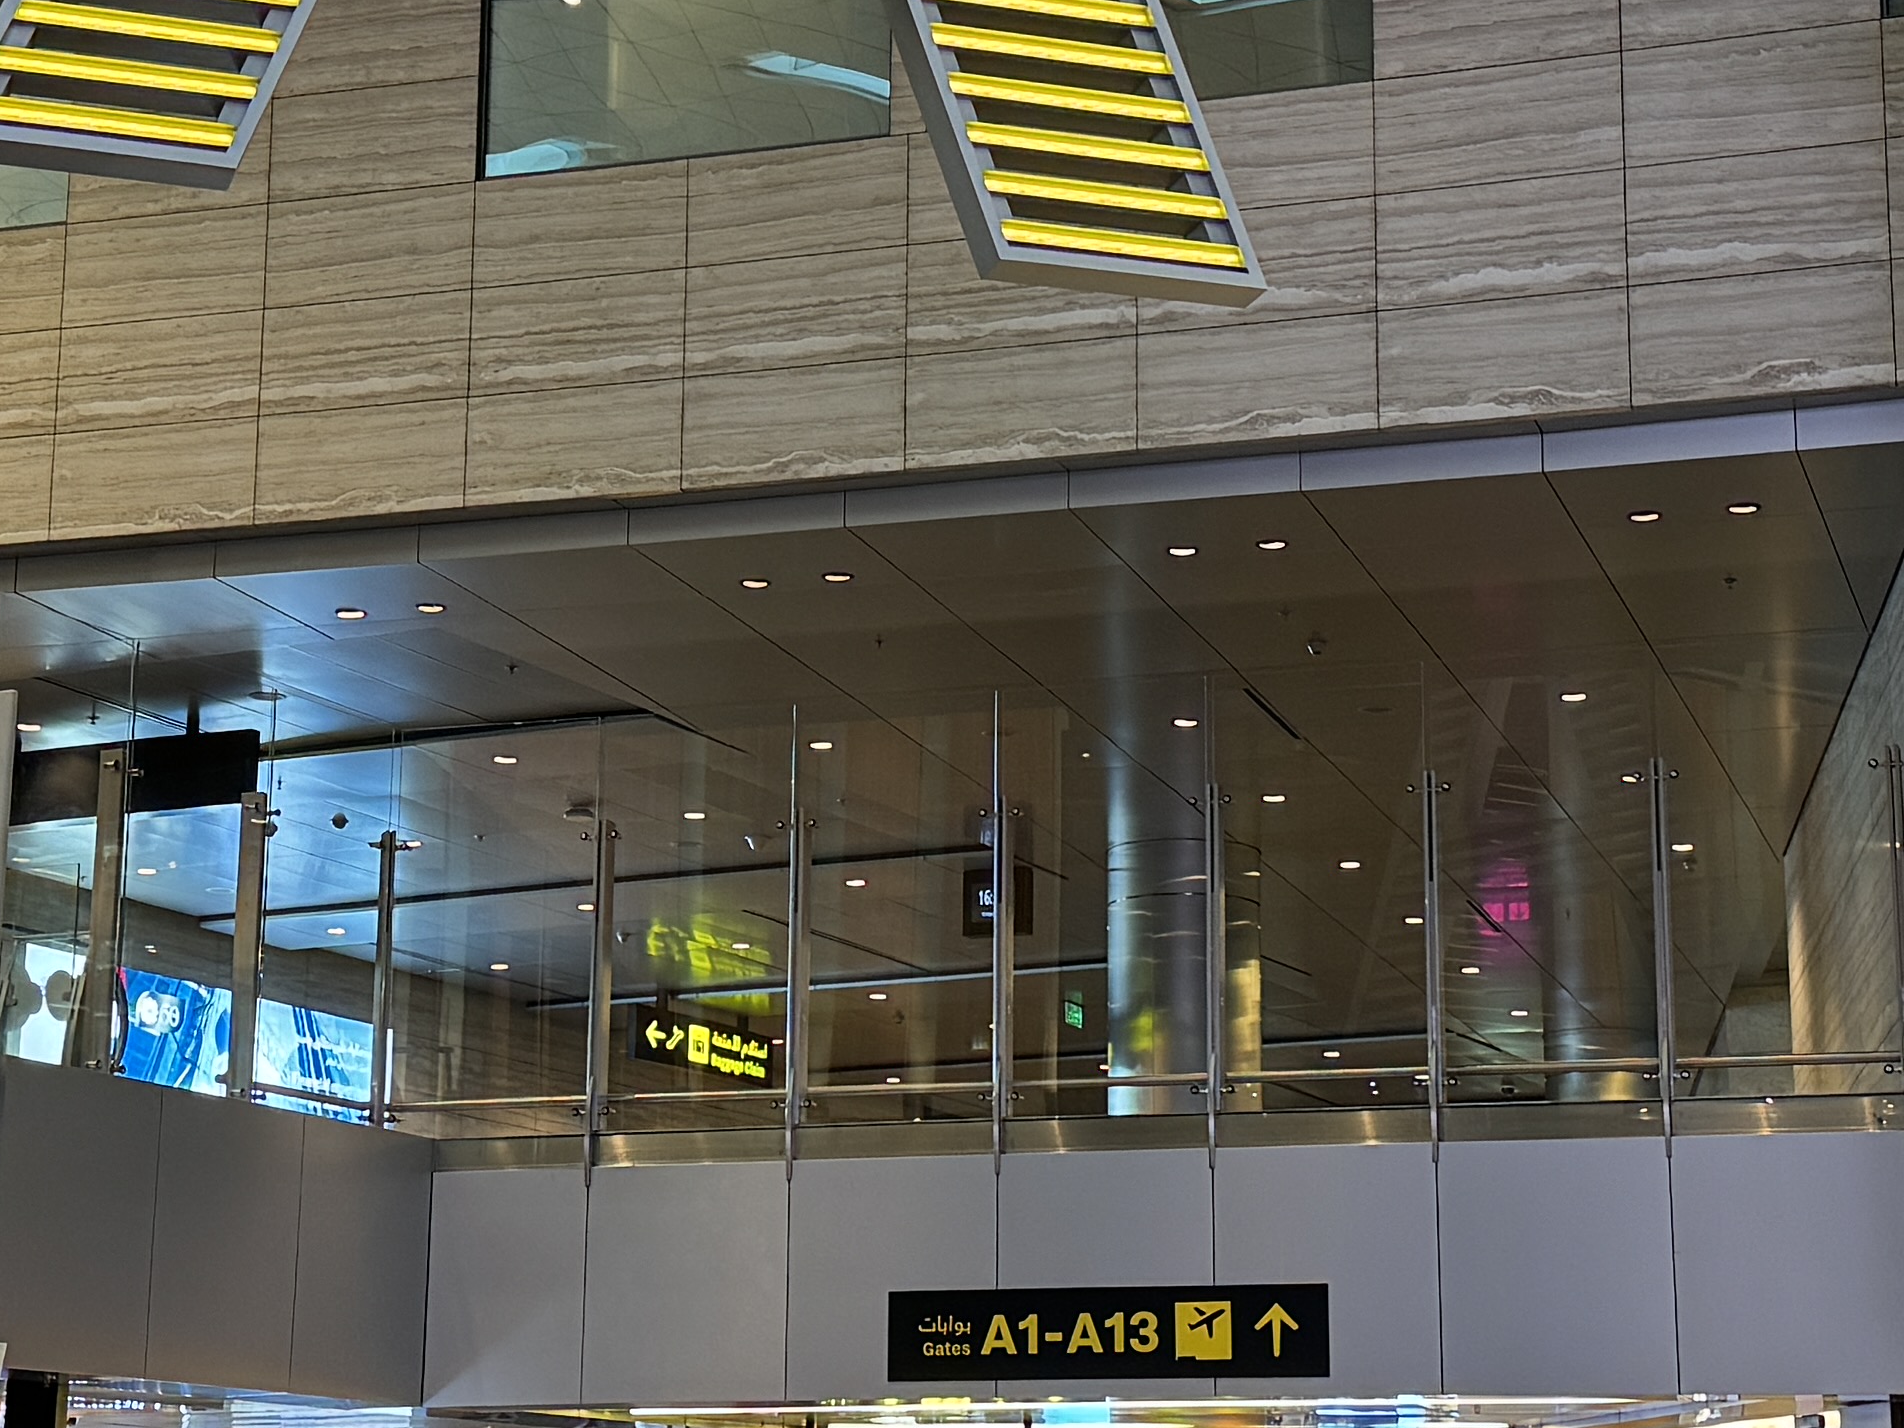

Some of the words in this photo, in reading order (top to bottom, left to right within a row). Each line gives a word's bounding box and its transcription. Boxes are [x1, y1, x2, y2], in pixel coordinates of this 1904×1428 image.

[917, 1314, 972, 1337] بوابات
[922, 1340, 971, 1357] Gates
[980, 1311, 1160, 1356] A1-A13
